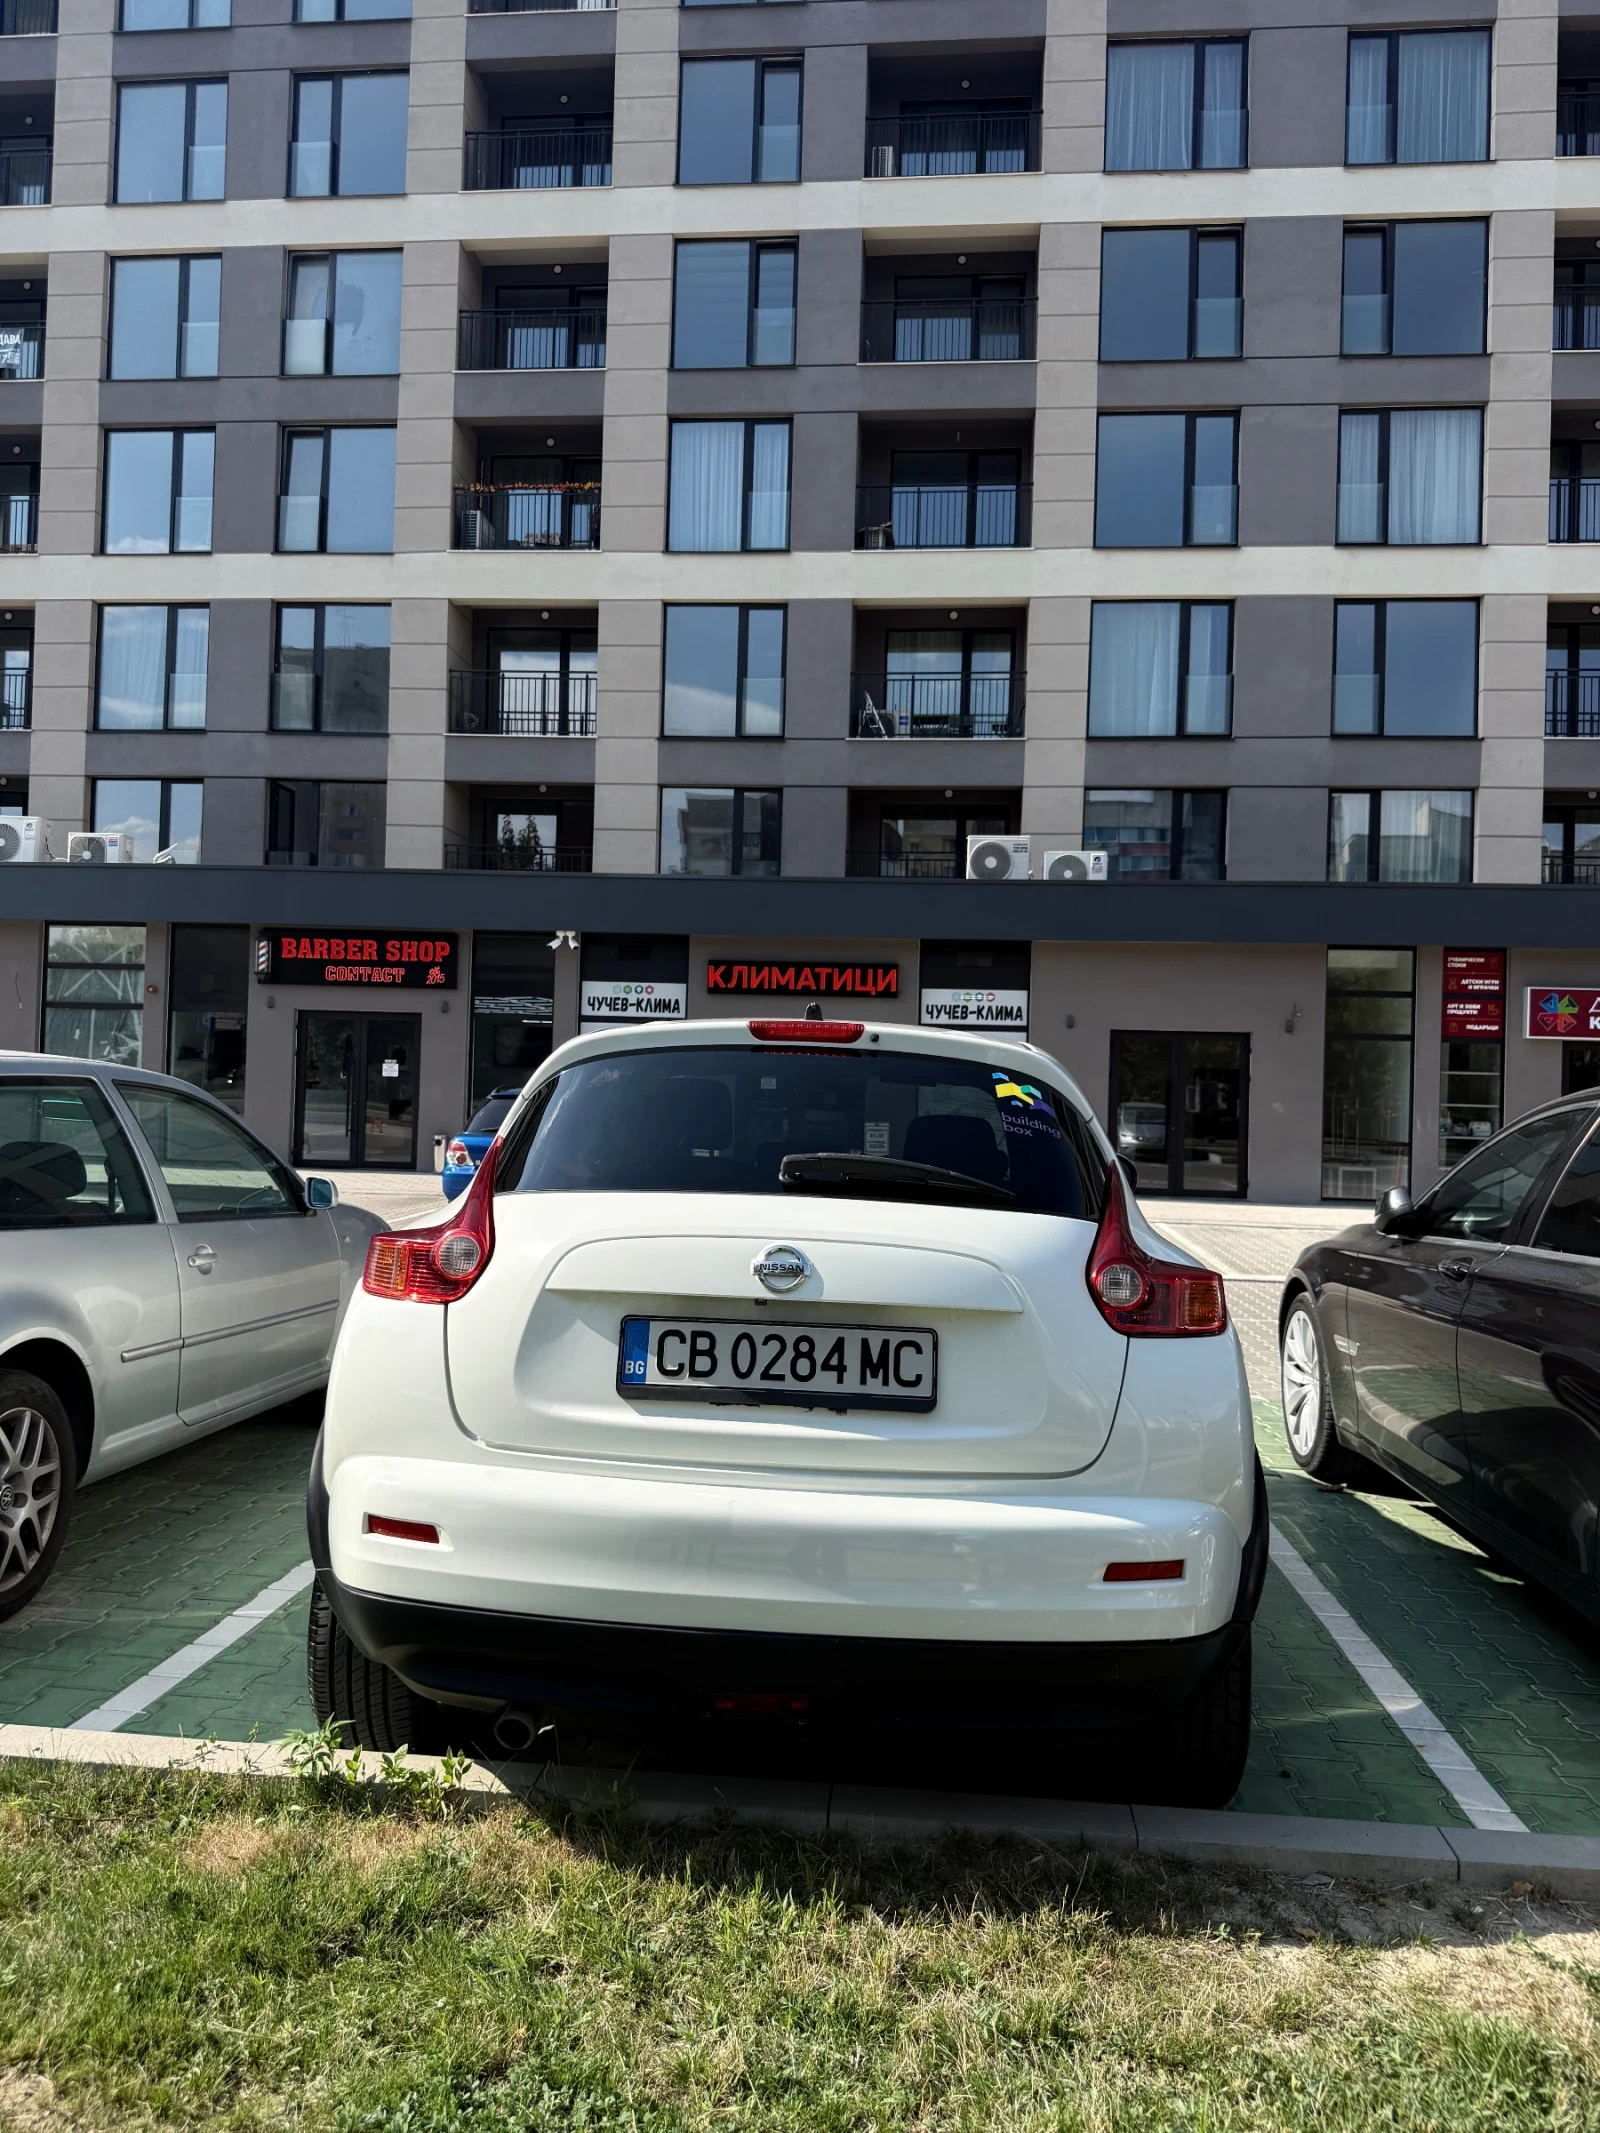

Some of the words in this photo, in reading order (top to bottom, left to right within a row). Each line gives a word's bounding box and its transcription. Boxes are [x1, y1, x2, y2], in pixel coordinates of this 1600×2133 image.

[281, 937, 378, 961] BARBER
[386, 940, 450, 962] SHOP
[325, 965, 405, 983] CONTACT
[425, 973, 446, 985] 2015
[708, 965, 897, 995] КЛИМАТИЦИ
[587, 996, 681, 1014] ЧУЧЕВ-КЛИМА
[925, 1004, 1023, 1022] ЧУЧЕВ-КЛИМА
[1001, 1112, 1061, 1138] building
[1003, 1121, 1033, 1137] box
[759, 1263, 804, 1274] NISSAN
[624, 1360, 645, 1375] BG
[656, 1329, 718, 1380] CB
[731, 1332, 848, 1385] 0284
[859, 1337, 923, 1388] MC
